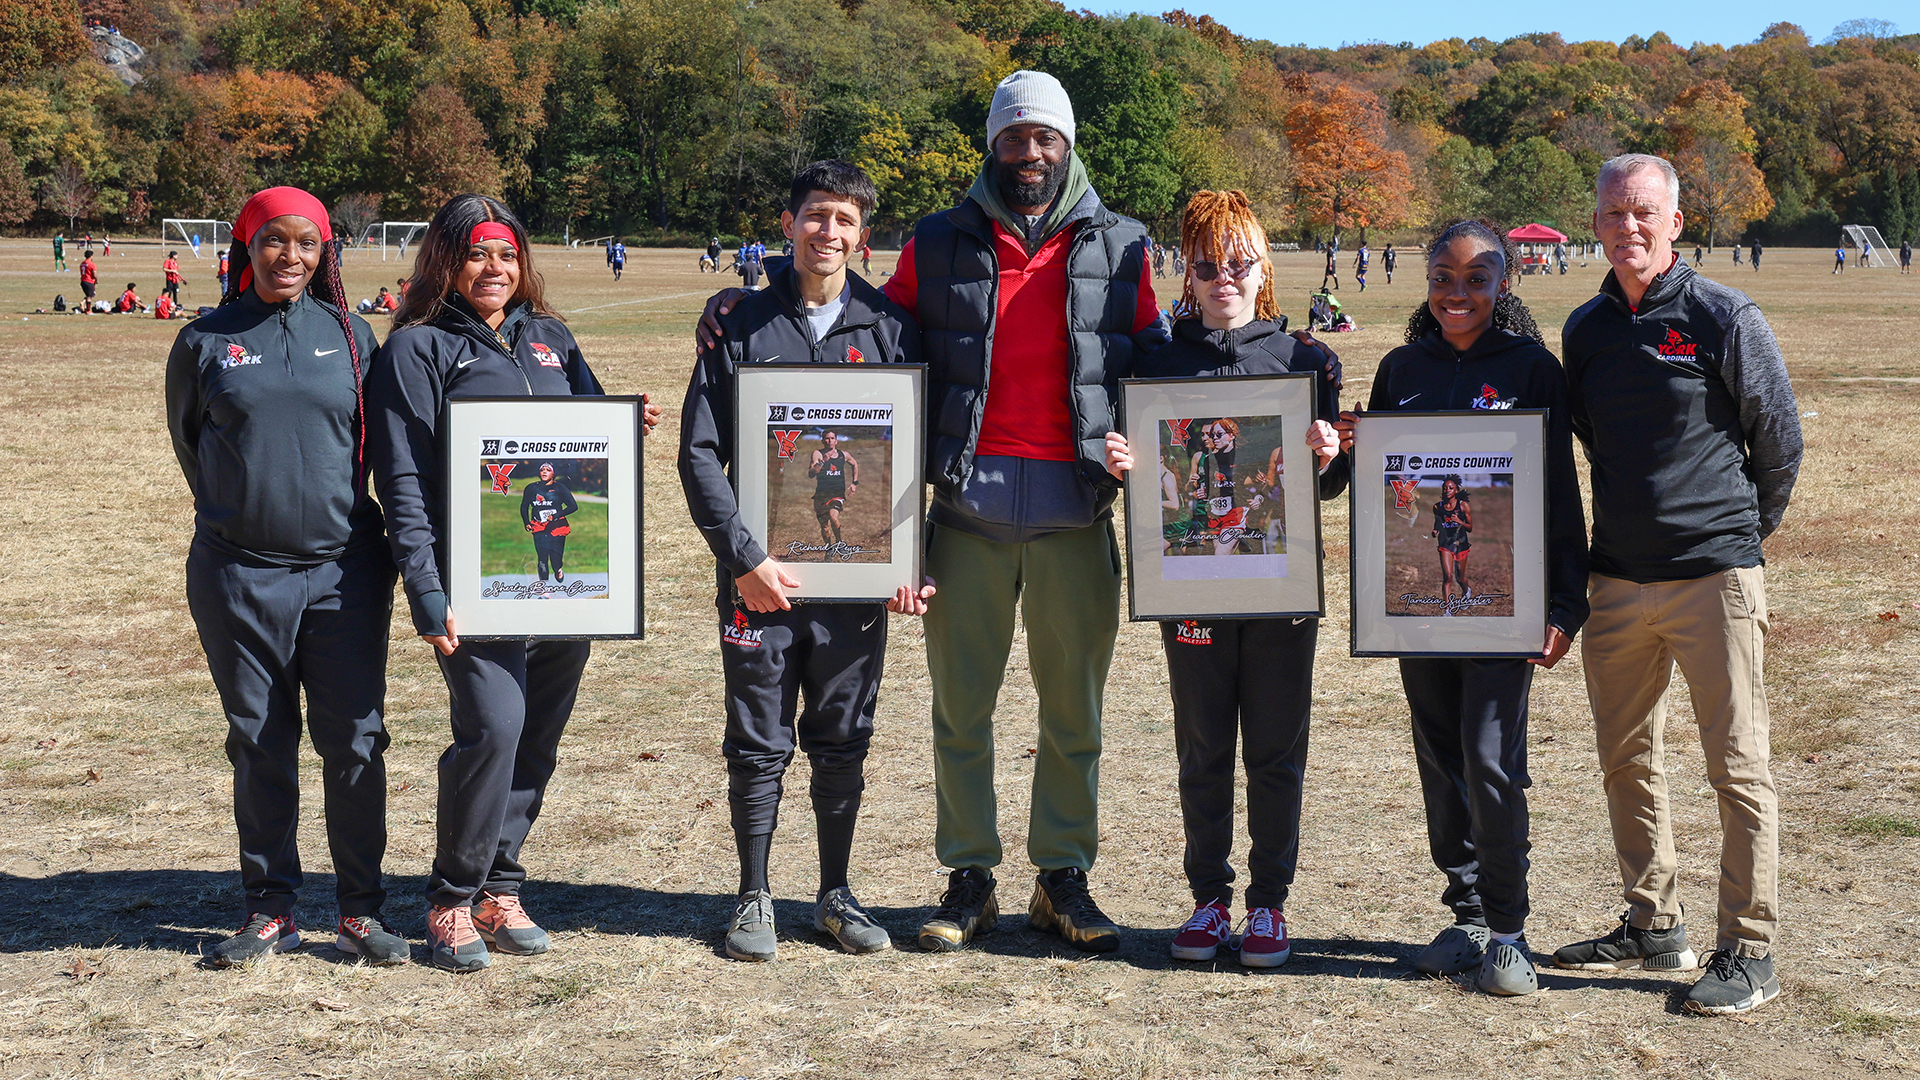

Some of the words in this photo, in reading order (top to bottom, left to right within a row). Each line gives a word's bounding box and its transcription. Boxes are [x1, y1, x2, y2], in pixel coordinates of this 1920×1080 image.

[1658, 343, 1697, 355] YORK
[221, 354, 262, 369] YORK
[532, 351, 560, 362] YOR
[807, 408, 841, 419] CROSS
[844, 409, 892, 420] COUNTRY
[521, 442, 557, 453] CROSS
[559, 441, 608, 453] COUNTRY
[1425, 457, 1460, 468] CROSS
[1463, 456, 1513, 468] COUNTRY
[785, 540, 830, 557] Richard
[829, 540, 880, 561] Reyes
[723, 624, 764, 642] YORK
[1177, 623, 1212, 639] YORK
[1177, 636, 1211, 645] ATHLETICS
